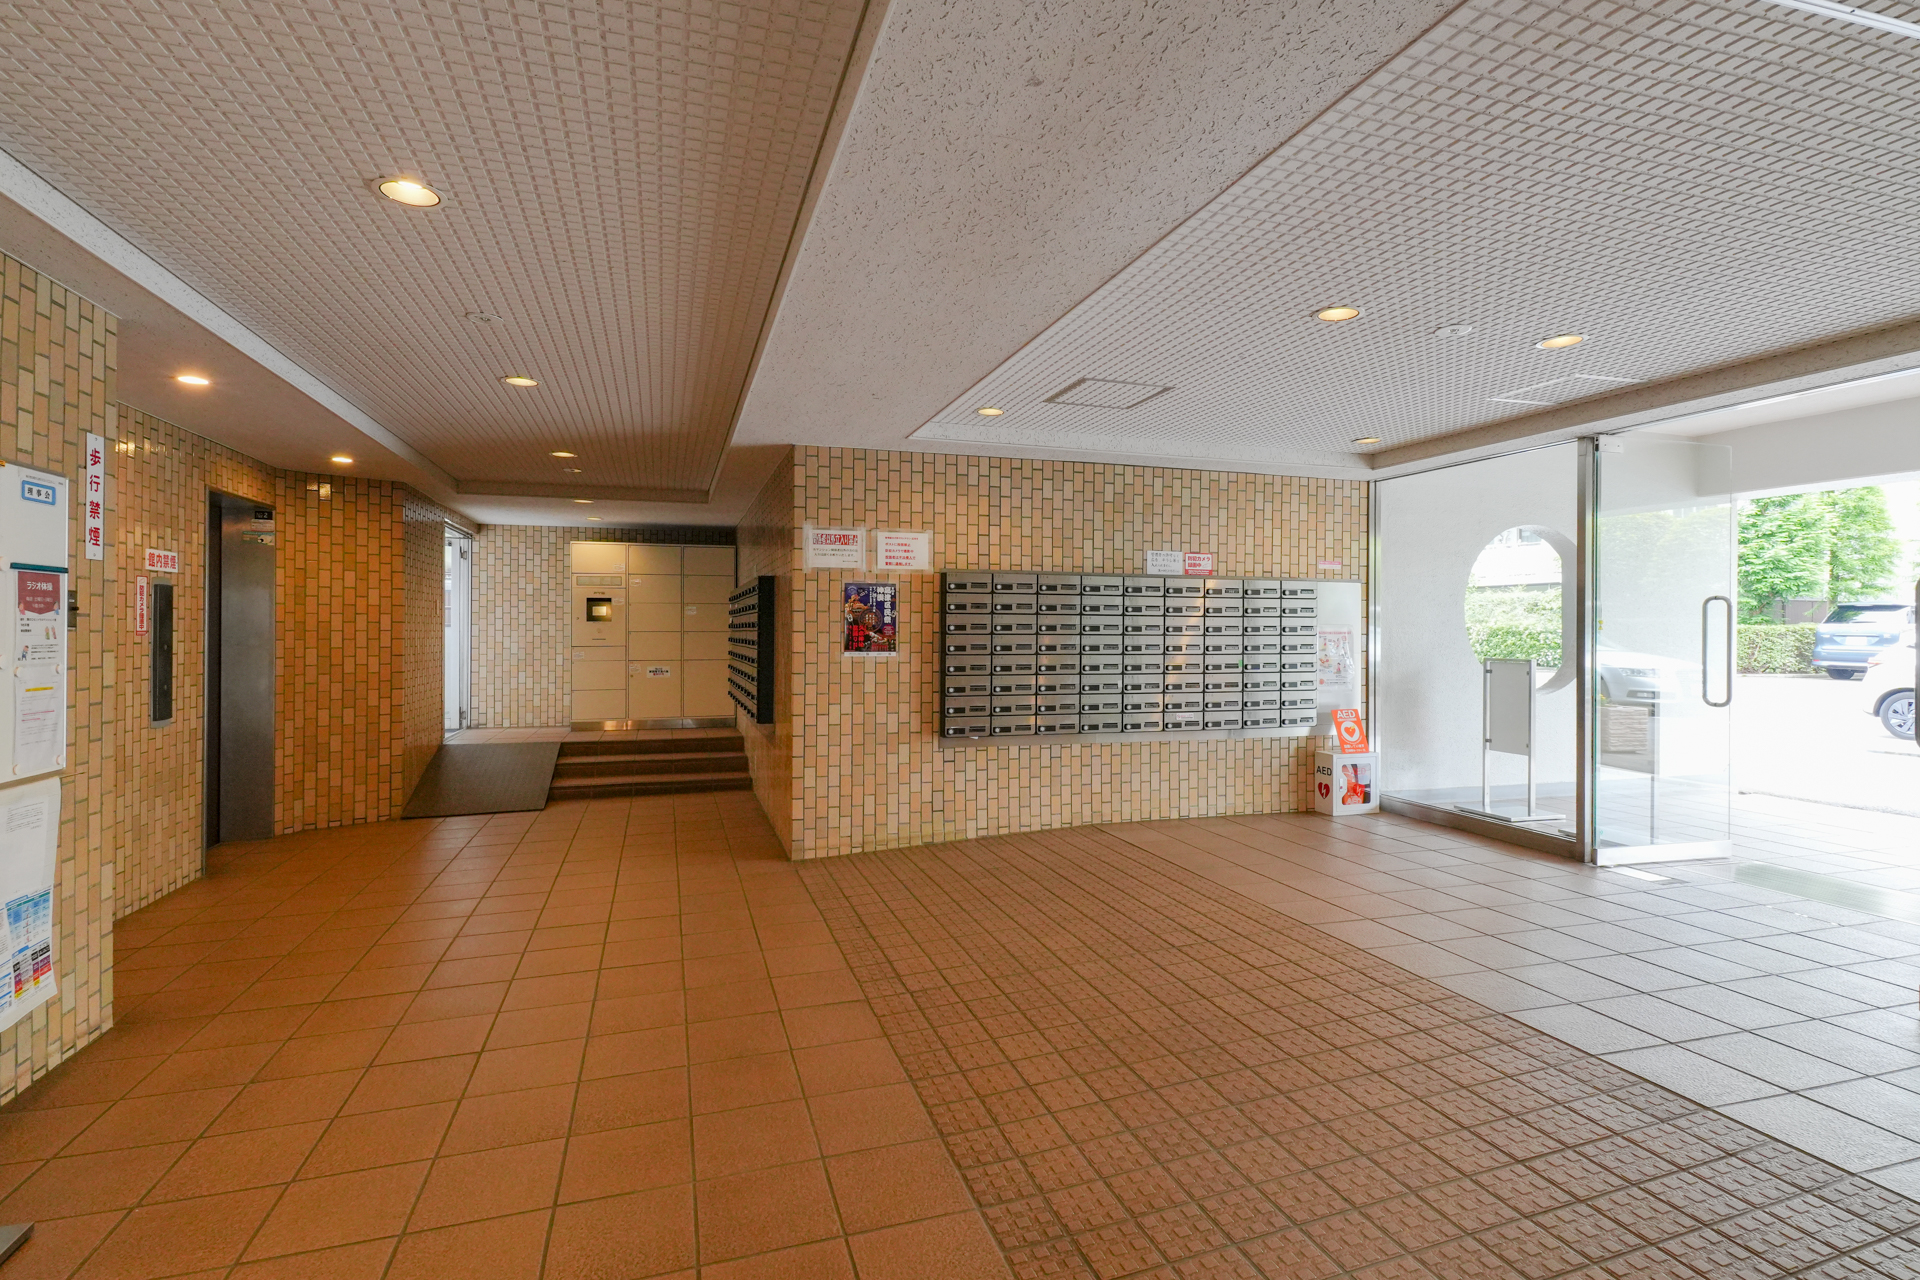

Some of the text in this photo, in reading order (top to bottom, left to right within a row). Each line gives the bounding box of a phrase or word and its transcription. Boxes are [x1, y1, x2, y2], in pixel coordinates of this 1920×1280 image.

[27, 486, 50, 500] 理事会
[88, 448, 102, 547] 歩行禁煙
[148, 552, 177, 570] 館内禁煙
[26, 581, 53, 591] ラジオ体操
[1337, 710, 1355, 718] AED
[1316, 766, 1332, 776] AED
